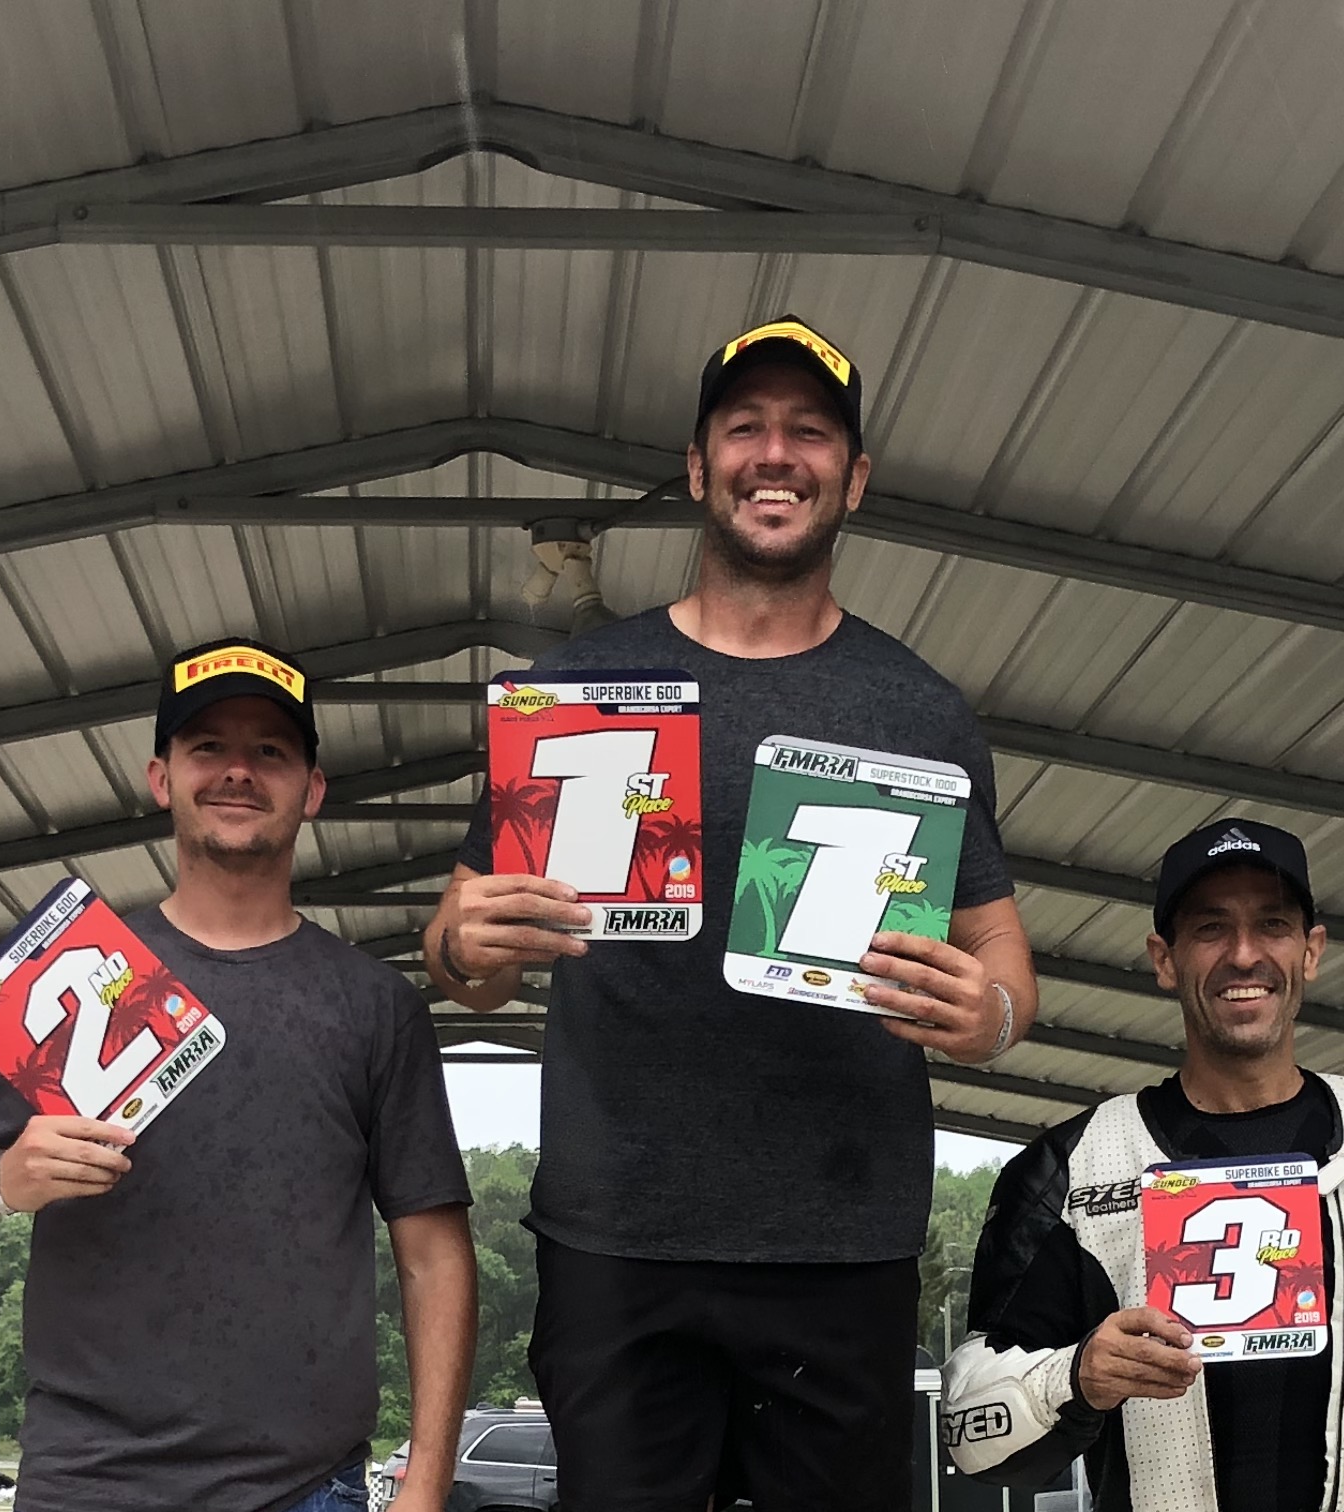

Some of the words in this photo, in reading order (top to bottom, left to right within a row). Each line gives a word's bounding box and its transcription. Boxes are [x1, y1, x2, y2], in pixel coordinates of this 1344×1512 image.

[187, 656, 295, 688] PIRELLI
[501, 693, 556, 708] SUNOCO
[582, 685, 652, 702] SUPERBIKE
[657, 685, 682, 701] 600
[773, 746, 857, 780] FMRRA
[869, 767, 933, 788] SUPERSTOCK
[935, 778, 958, 792] 1000
[622, 793, 674, 819] Place
[1207, 839, 1261, 857] adidas
[664, 883, 696, 899] 2019
[875, 872, 928, 895] Place
[8, 909, 60, 964] SUPERBIKE
[58, 890, 78, 914] 600
[605, 908, 688, 934] FMRRA
[765, 964, 793, 978] FTD
[100, 967, 134, 1009] Place
[738, 978, 775, 990] MYLAPS
[176, 1006, 202, 1035] 2019
[155, 1029, 219, 1096] FMRRA
[1225, 1166, 1280, 1180] SUPERBIKE
[1282, 1164, 1304, 1176] 600
[1071, 1180, 1142, 1208] SYE
[1152, 1177, 1198, 1190] SUNOCO
[1086, 1198, 1137, 1215] Leathers
[1256, 1247, 1298, 1266] Place
[1294, 1311, 1321, 1324] 2019
[1245, 1331, 1315, 1353] FMRRA
